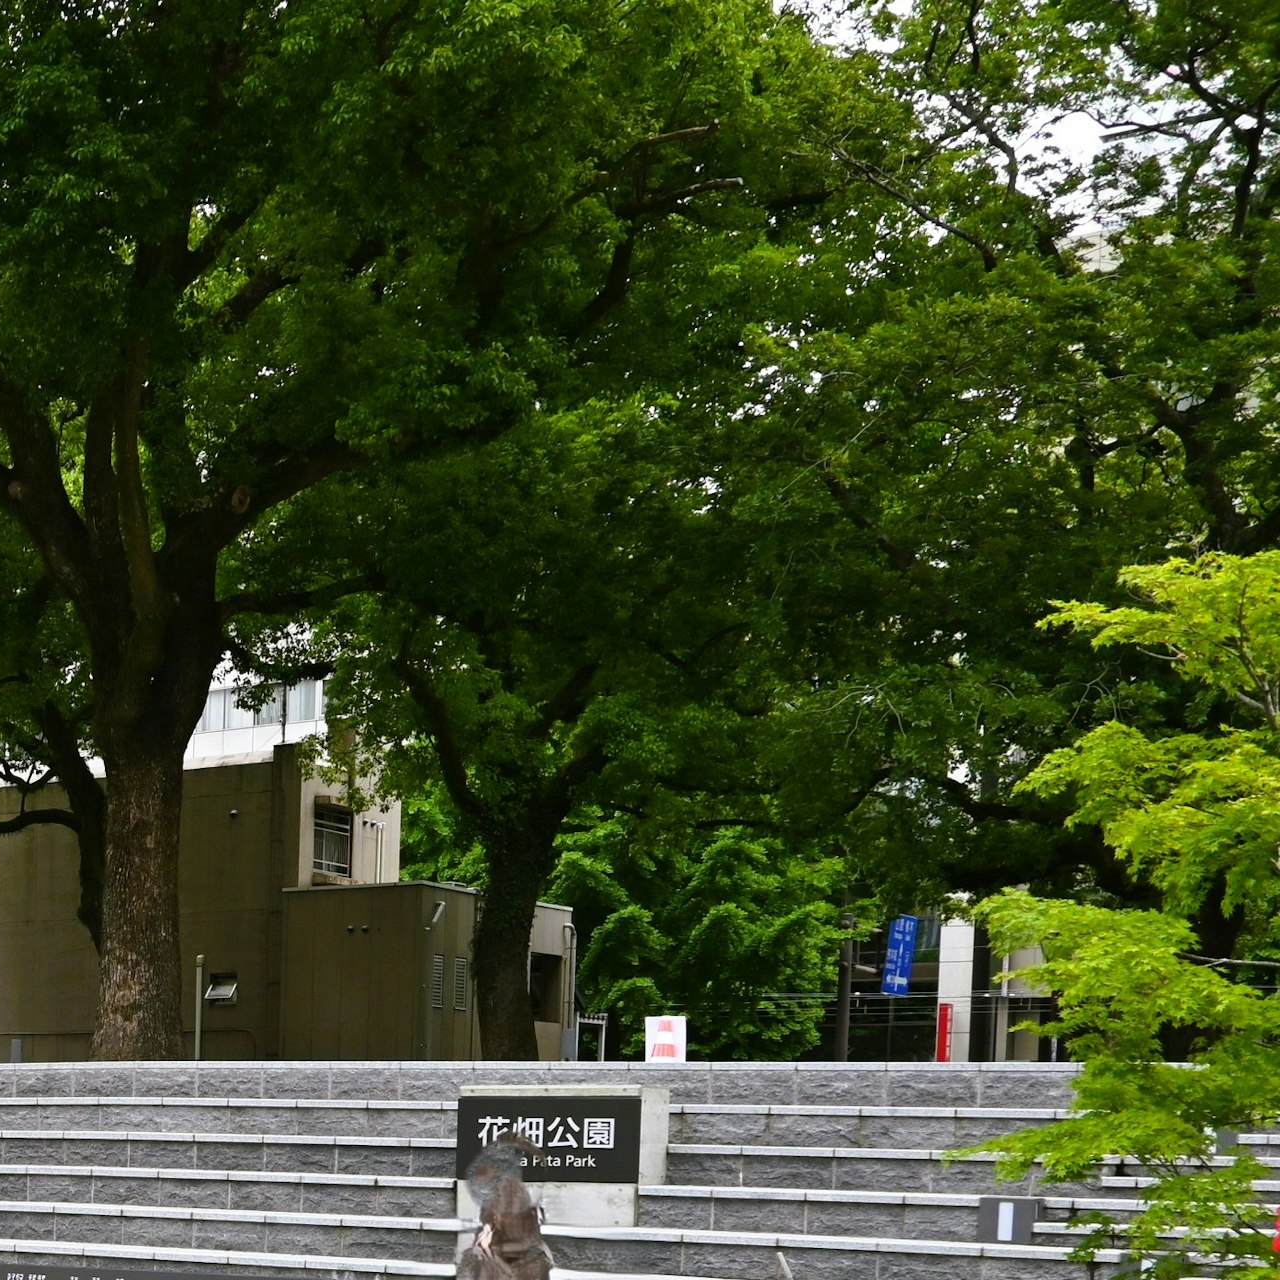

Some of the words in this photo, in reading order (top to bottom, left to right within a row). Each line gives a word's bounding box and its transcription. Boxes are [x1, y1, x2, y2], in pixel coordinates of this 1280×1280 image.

[477, 1115, 616, 1149] 花畑公園
[565, 1154, 596, 1167] Park
